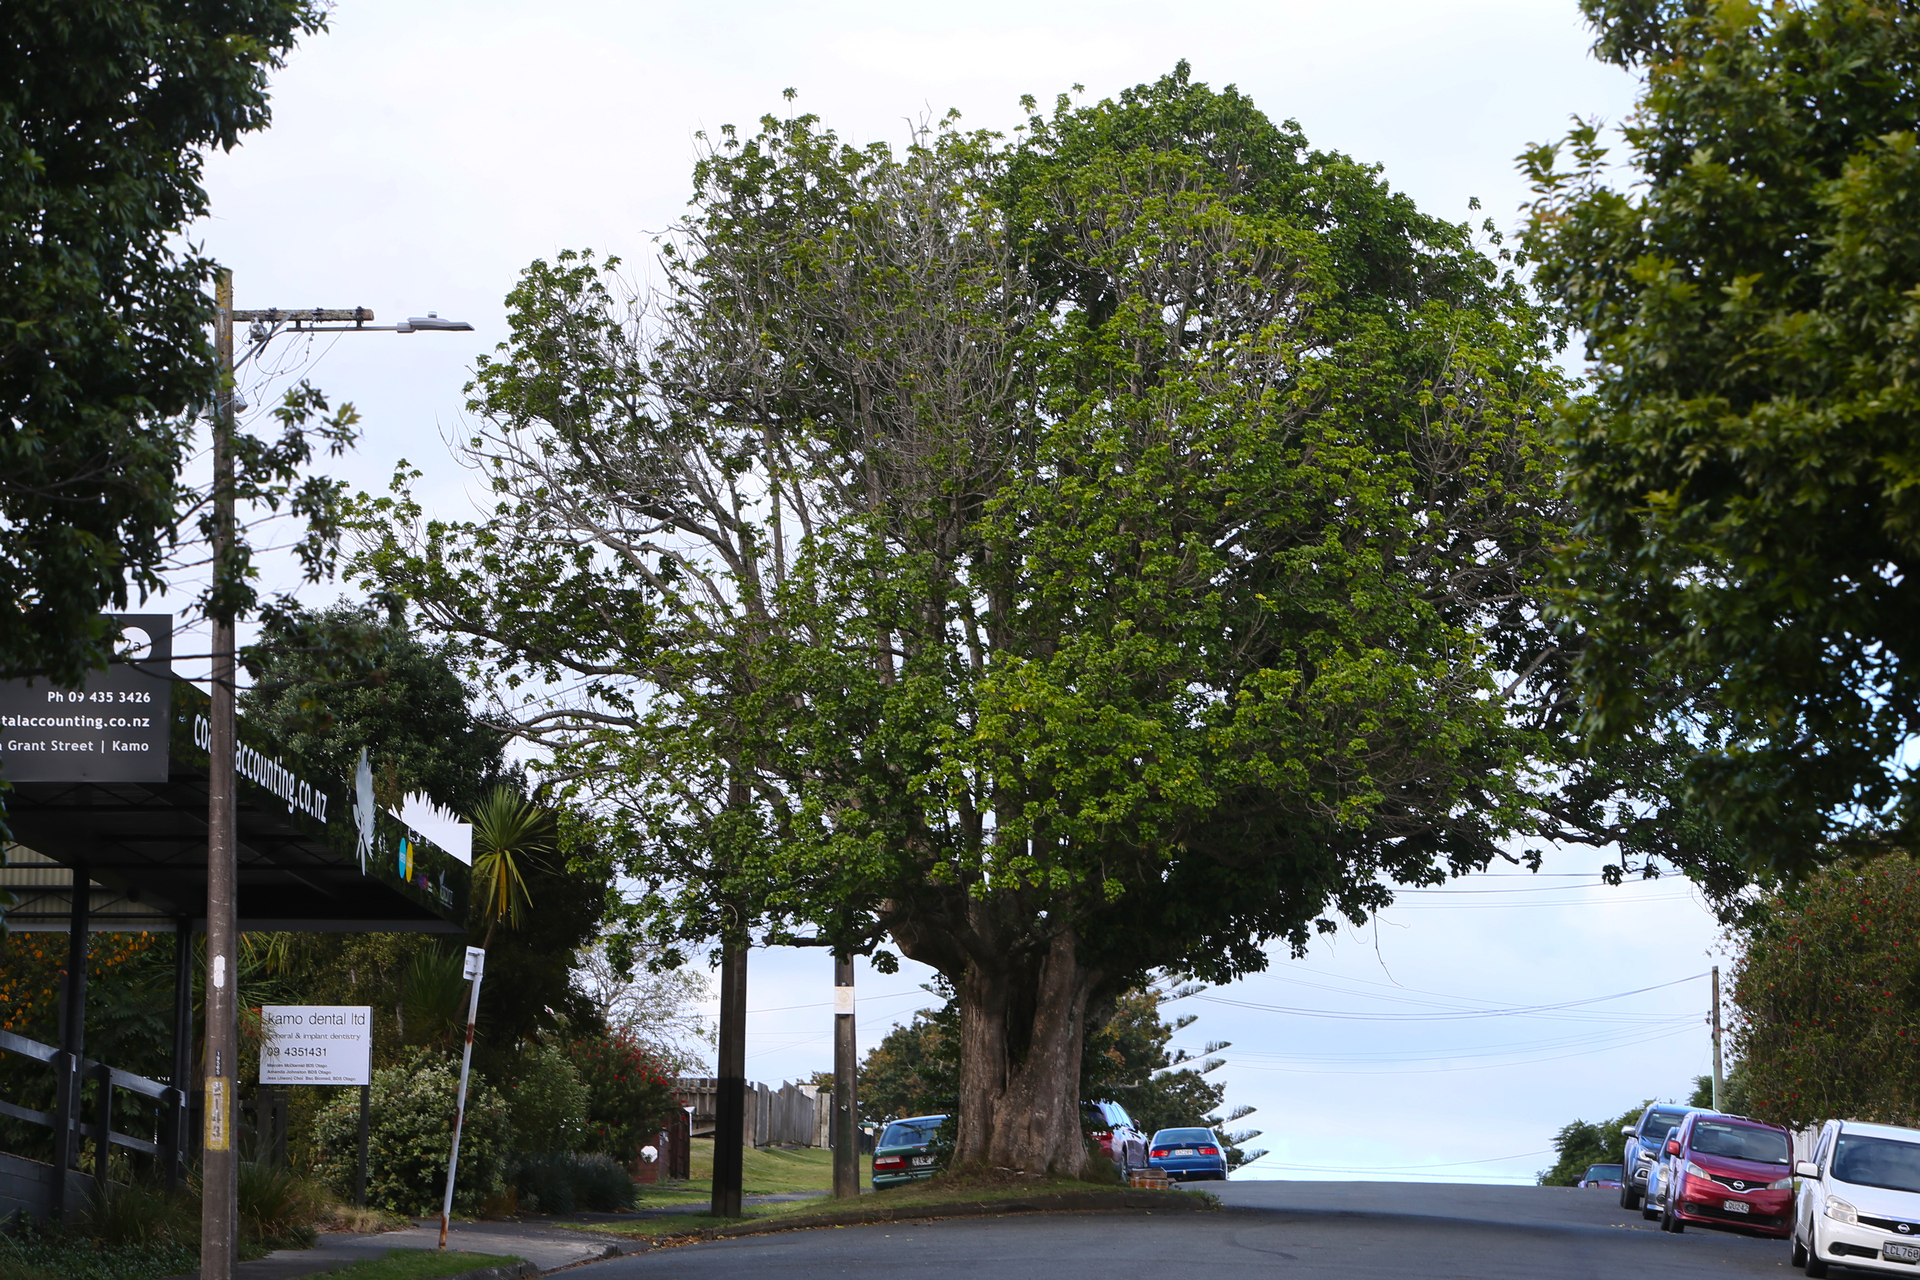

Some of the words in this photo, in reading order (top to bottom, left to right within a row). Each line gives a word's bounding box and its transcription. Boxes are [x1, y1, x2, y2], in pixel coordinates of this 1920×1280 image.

[47, 691, 64, 703] Ph
[68, 691, 85, 703] 09
[89, 692, 113, 703] 435
[118, 692, 151, 703] 3426
[7, 740, 46, 751] Grant
[51, 740, 94, 751] Street
[112, 740, 149, 751] Kamo
[268, 1012, 303, 1026] kamo
[308, 1012, 347, 1026] dental
[351, 1012, 366, 1026] ltd
[294, 1032, 302, 1040] &
[303, 1032, 329, 1042] implant
[330, 1032, 361, 1042] dentistry
[266, 1047, 280, 1057] 09
[284, 1047, 327, 1057] 4351431
